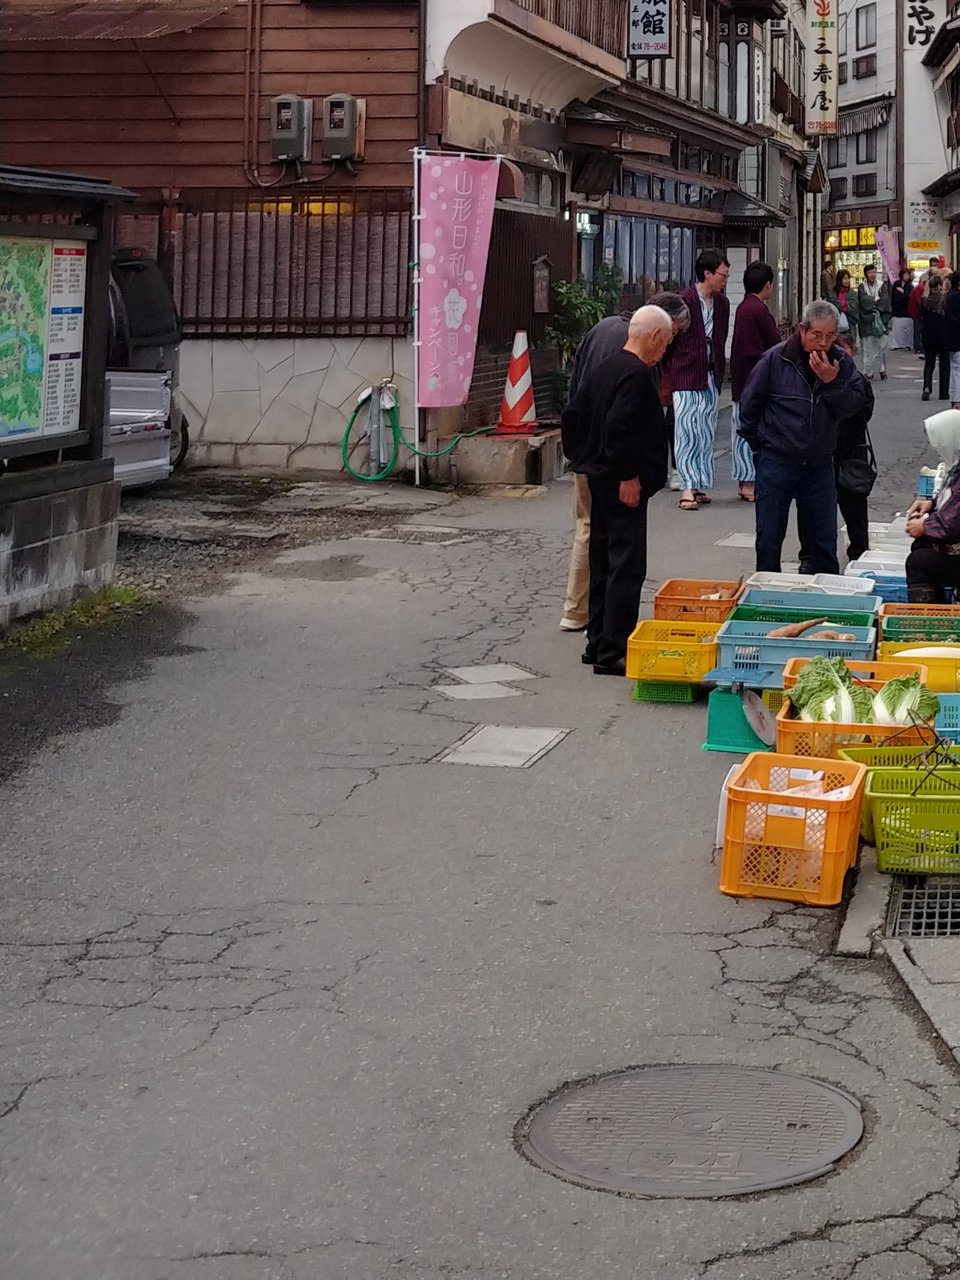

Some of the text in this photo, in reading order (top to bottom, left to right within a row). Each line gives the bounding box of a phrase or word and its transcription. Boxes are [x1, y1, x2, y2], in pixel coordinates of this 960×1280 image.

[810, 37, 833, 111] 三春屋
[428, 305, 442, 371] キャンペーン
